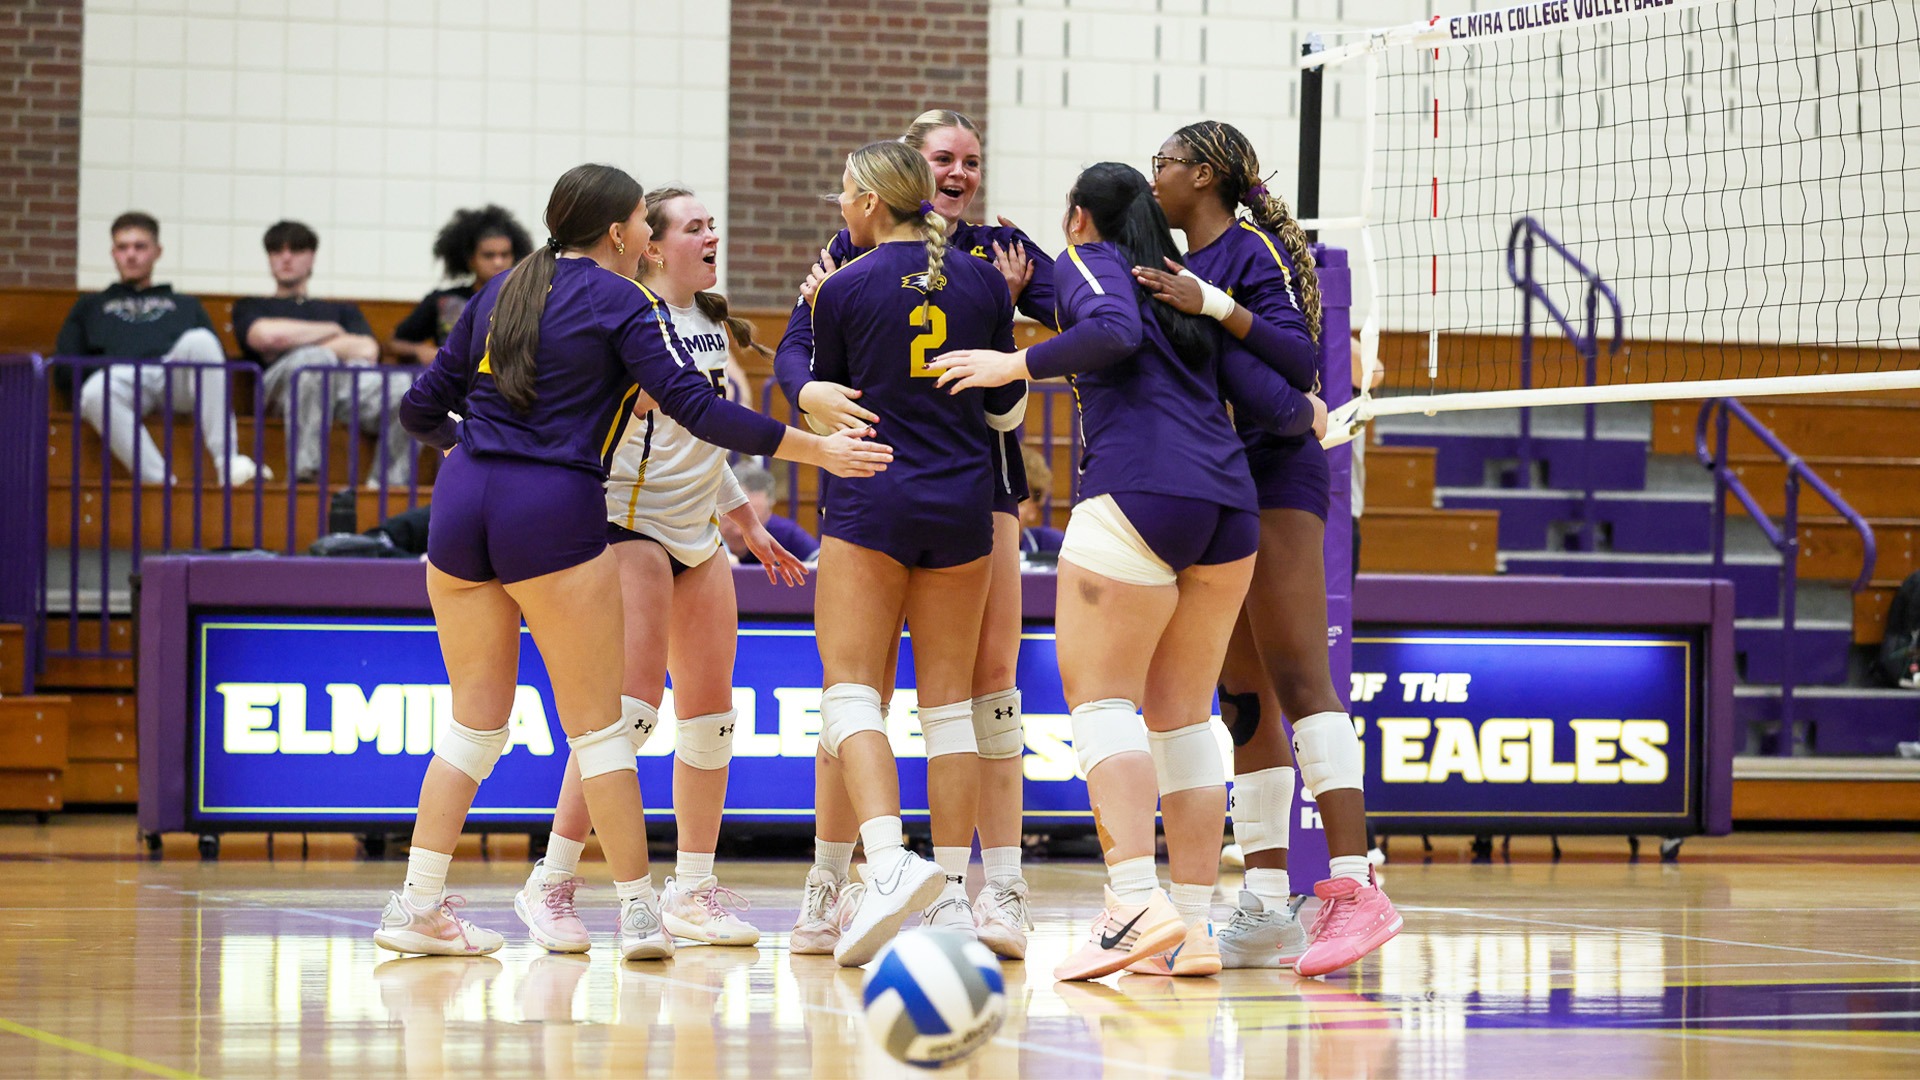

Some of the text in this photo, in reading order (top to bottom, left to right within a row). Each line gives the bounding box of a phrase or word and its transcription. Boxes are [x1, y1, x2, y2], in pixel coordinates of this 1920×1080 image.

[1450, 12, 1503, 39] ELMIRA
[1507, 0, 1570, 31] COLLEGE
[682, 333, 726, 354] MIRA
[909, 305, 948, 378] 2
[1399, 672, 1472, 703] THE
[1377, 717, 1670, 784] EAGLES
